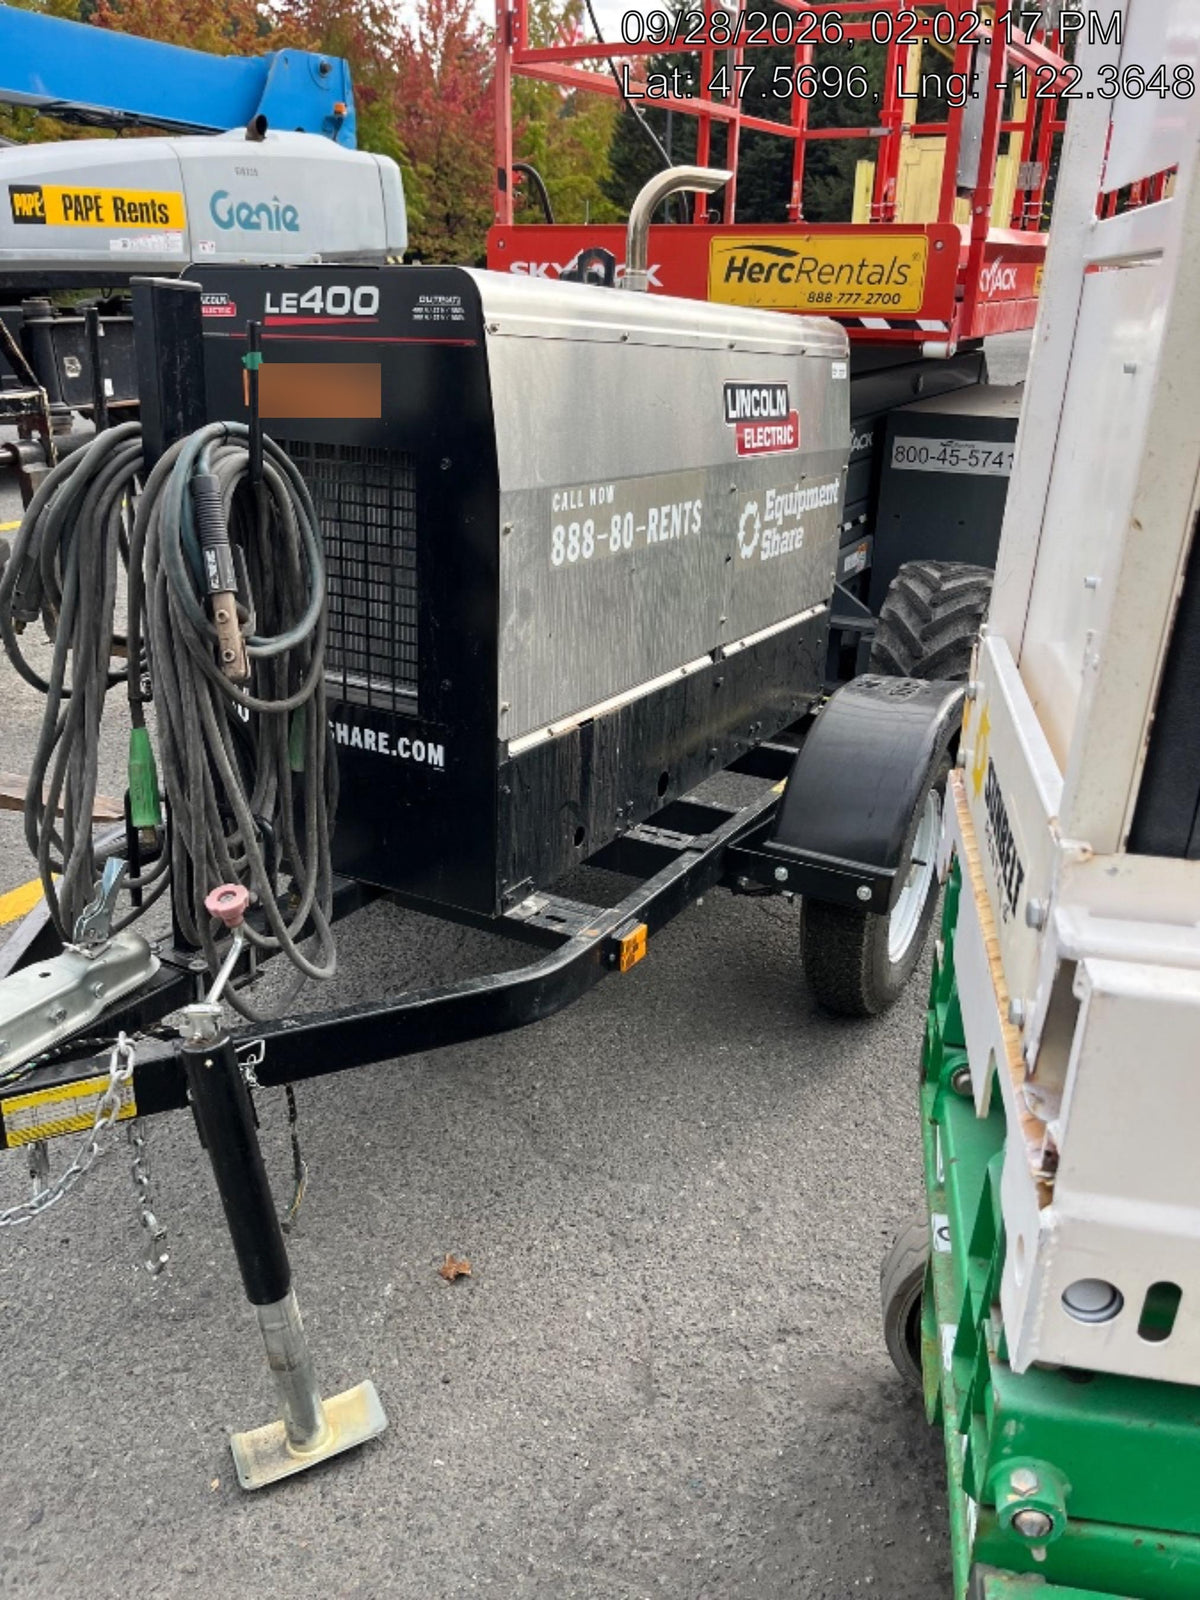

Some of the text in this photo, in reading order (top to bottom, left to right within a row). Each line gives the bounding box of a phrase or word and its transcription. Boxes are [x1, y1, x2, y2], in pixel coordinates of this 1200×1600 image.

[112, 196, 170, 225] Rents
[209, 189, 300, 232] Genie
[264, 285, 380, 316] LE400
[807, 291, 901, 305] 888-777-2700
[726, 388, 787, 419] LINCOLN
[743, 424, 794, 449] ELECTRIC
[552, 484, 617, 512] CALL NOW
[764, 478, 840, 526] Equipment
[551, 499, 703, 566] 888-80-RENTS
[761, 526, 804, 560] Share
